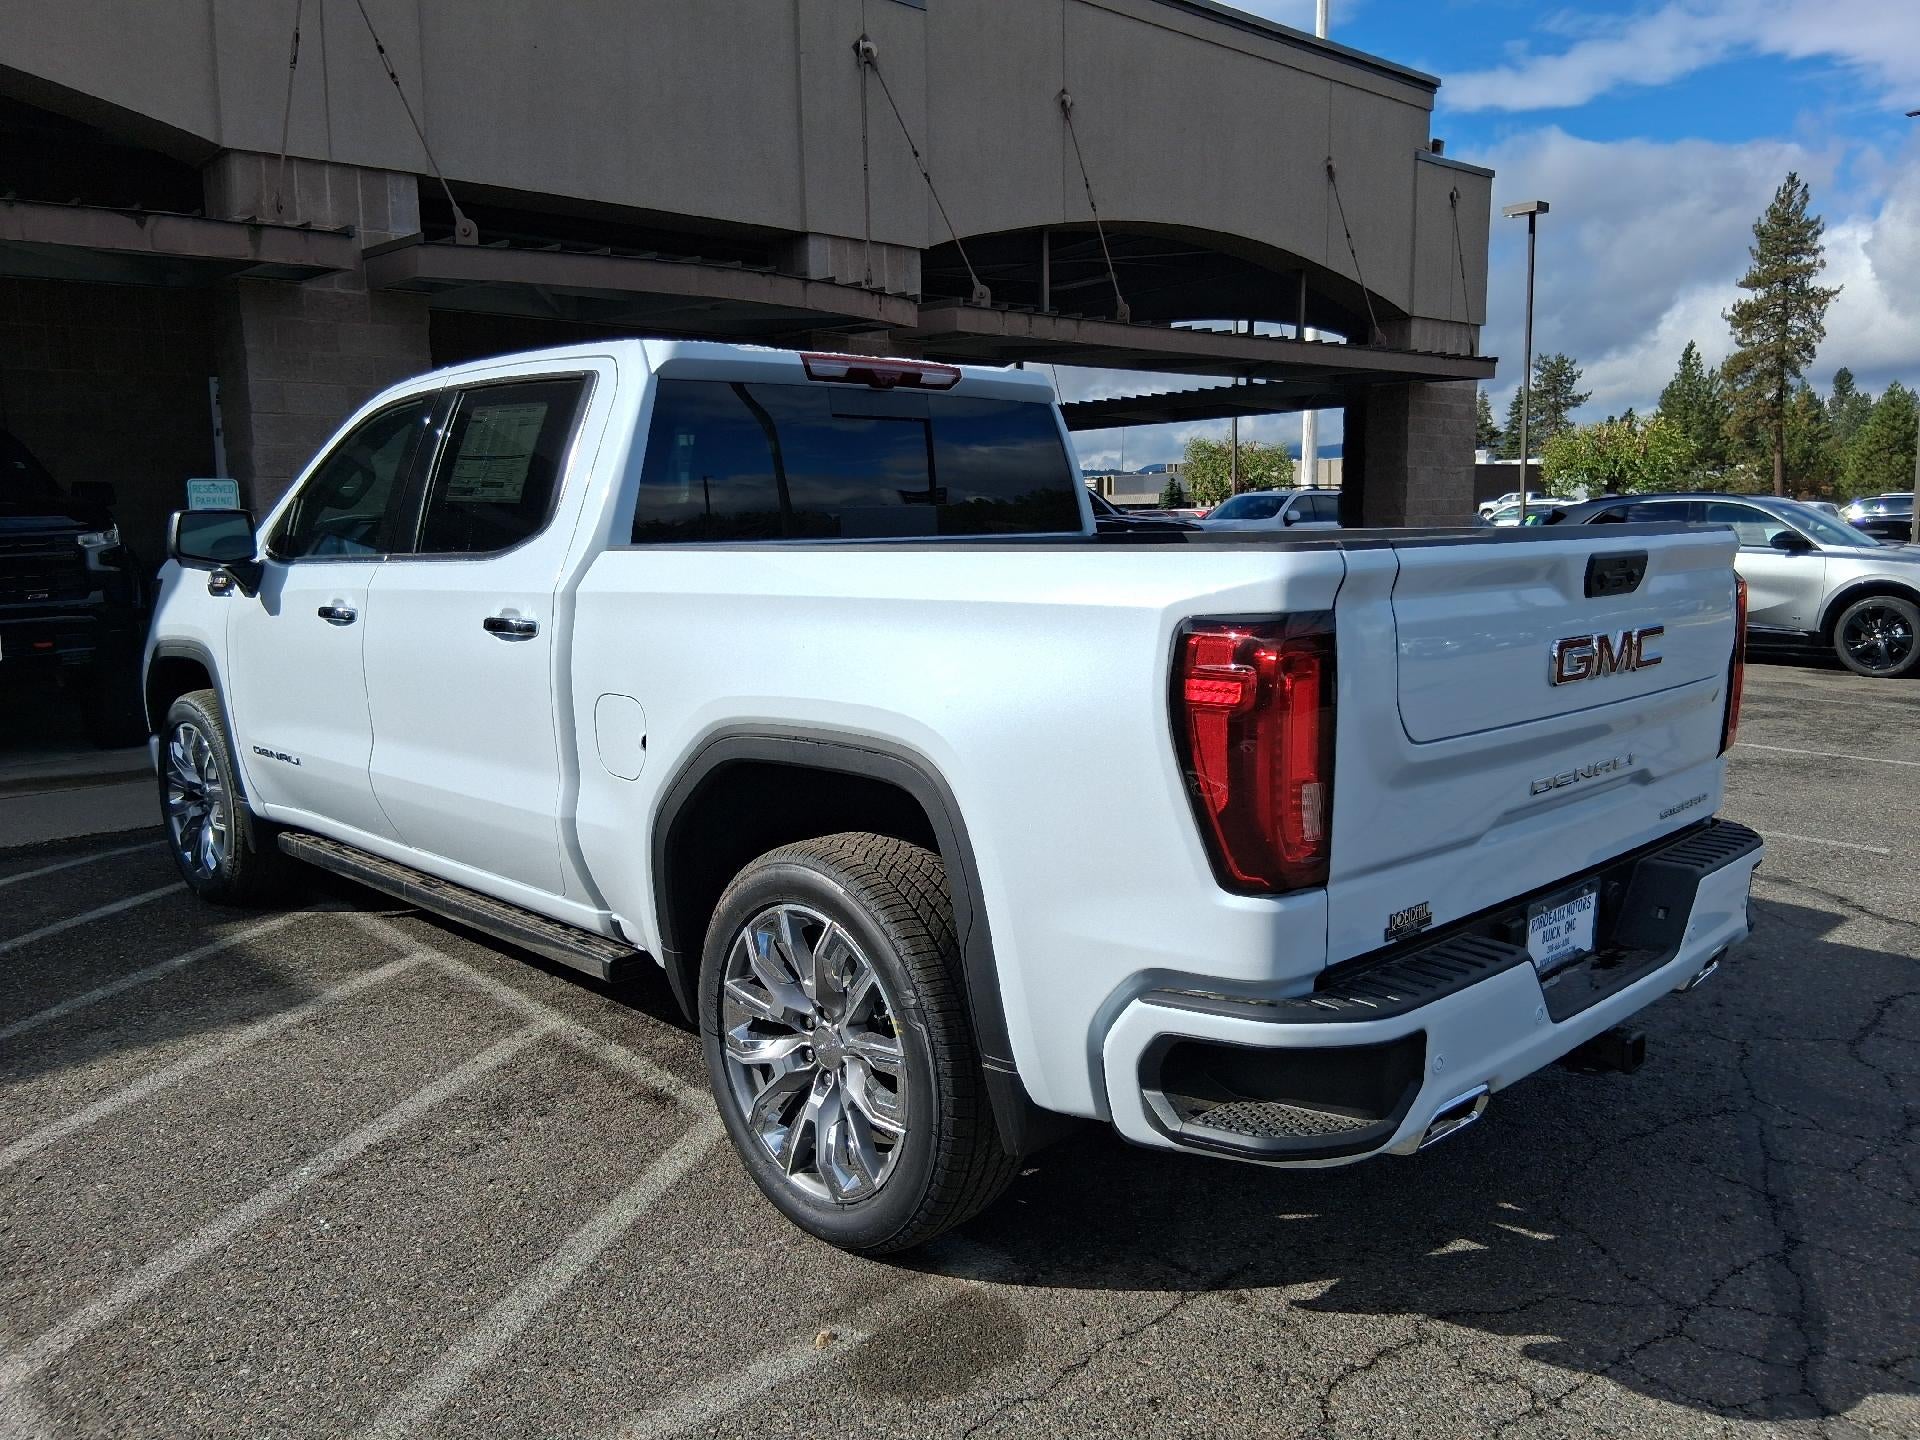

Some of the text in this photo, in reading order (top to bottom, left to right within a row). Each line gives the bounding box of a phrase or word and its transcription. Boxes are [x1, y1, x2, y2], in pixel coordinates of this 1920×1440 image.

[192, 484, 234, 494] RESERVED
[195, 496, 233, 505] PARKING
[1549, 625, 1664, 687] GMC
[253, 745, 301, 766] DENALI
[1529, 752, 1634, 796] DENALI
[1567, 896, 1591, 917] MOTORS
[1542, 925, 1560, 944] BUICK
